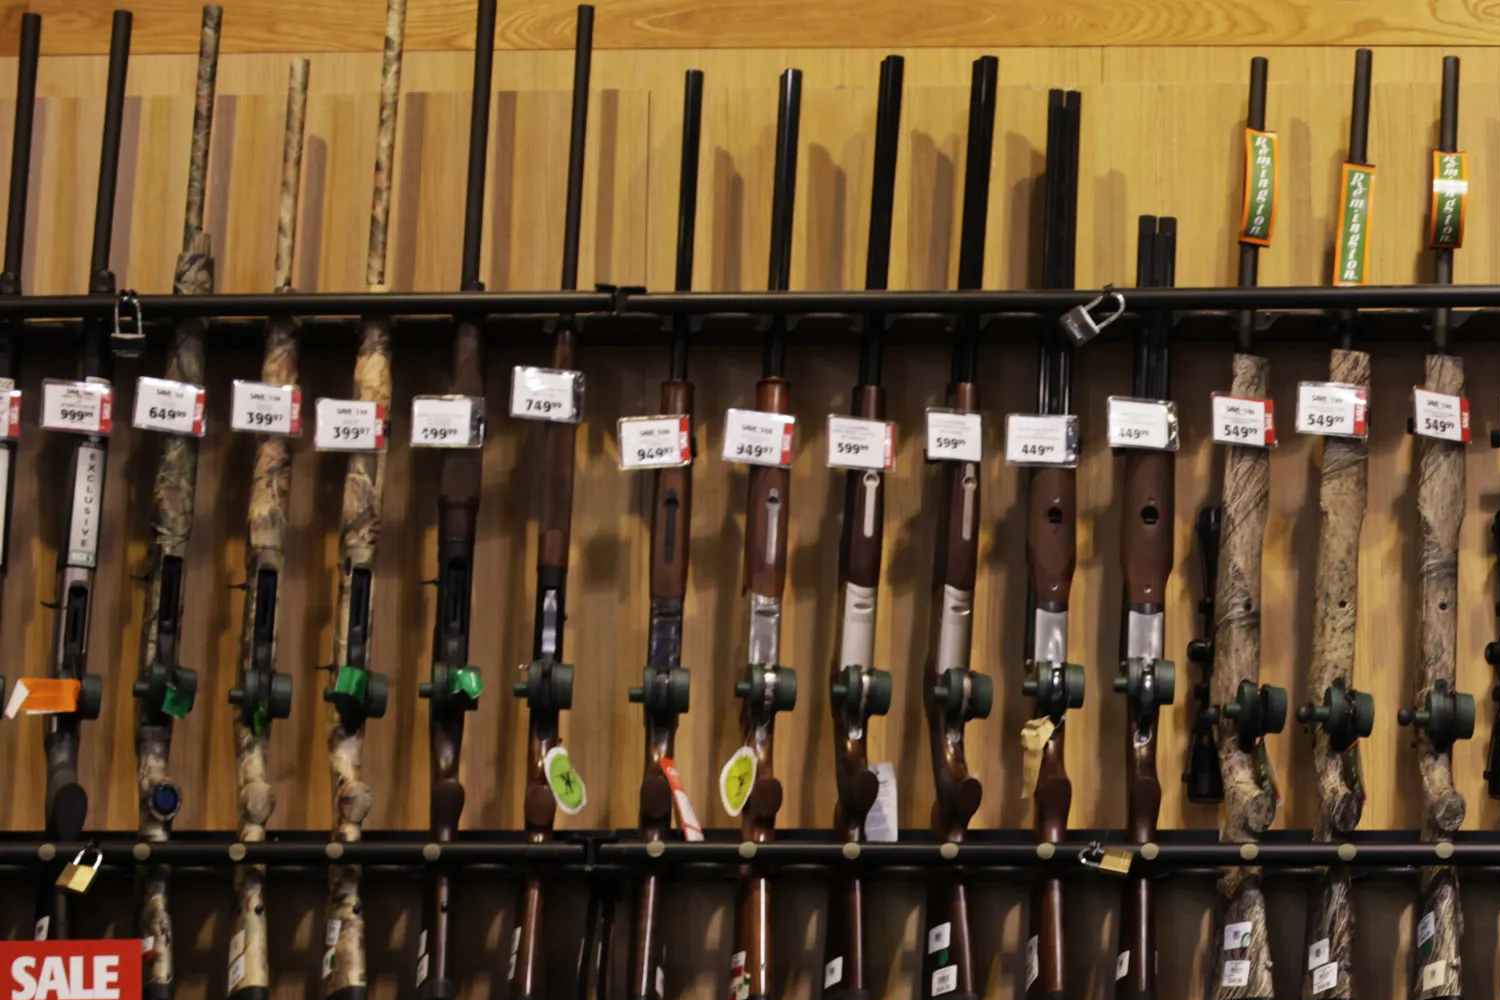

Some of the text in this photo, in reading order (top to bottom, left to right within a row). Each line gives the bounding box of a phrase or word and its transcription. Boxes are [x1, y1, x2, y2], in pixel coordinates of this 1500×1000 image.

[1249, 135, 1269, 237] Remington
[1343, 172, 1365, 281] Remington
[81, 453, 96, 547] EXCLUSIVE
